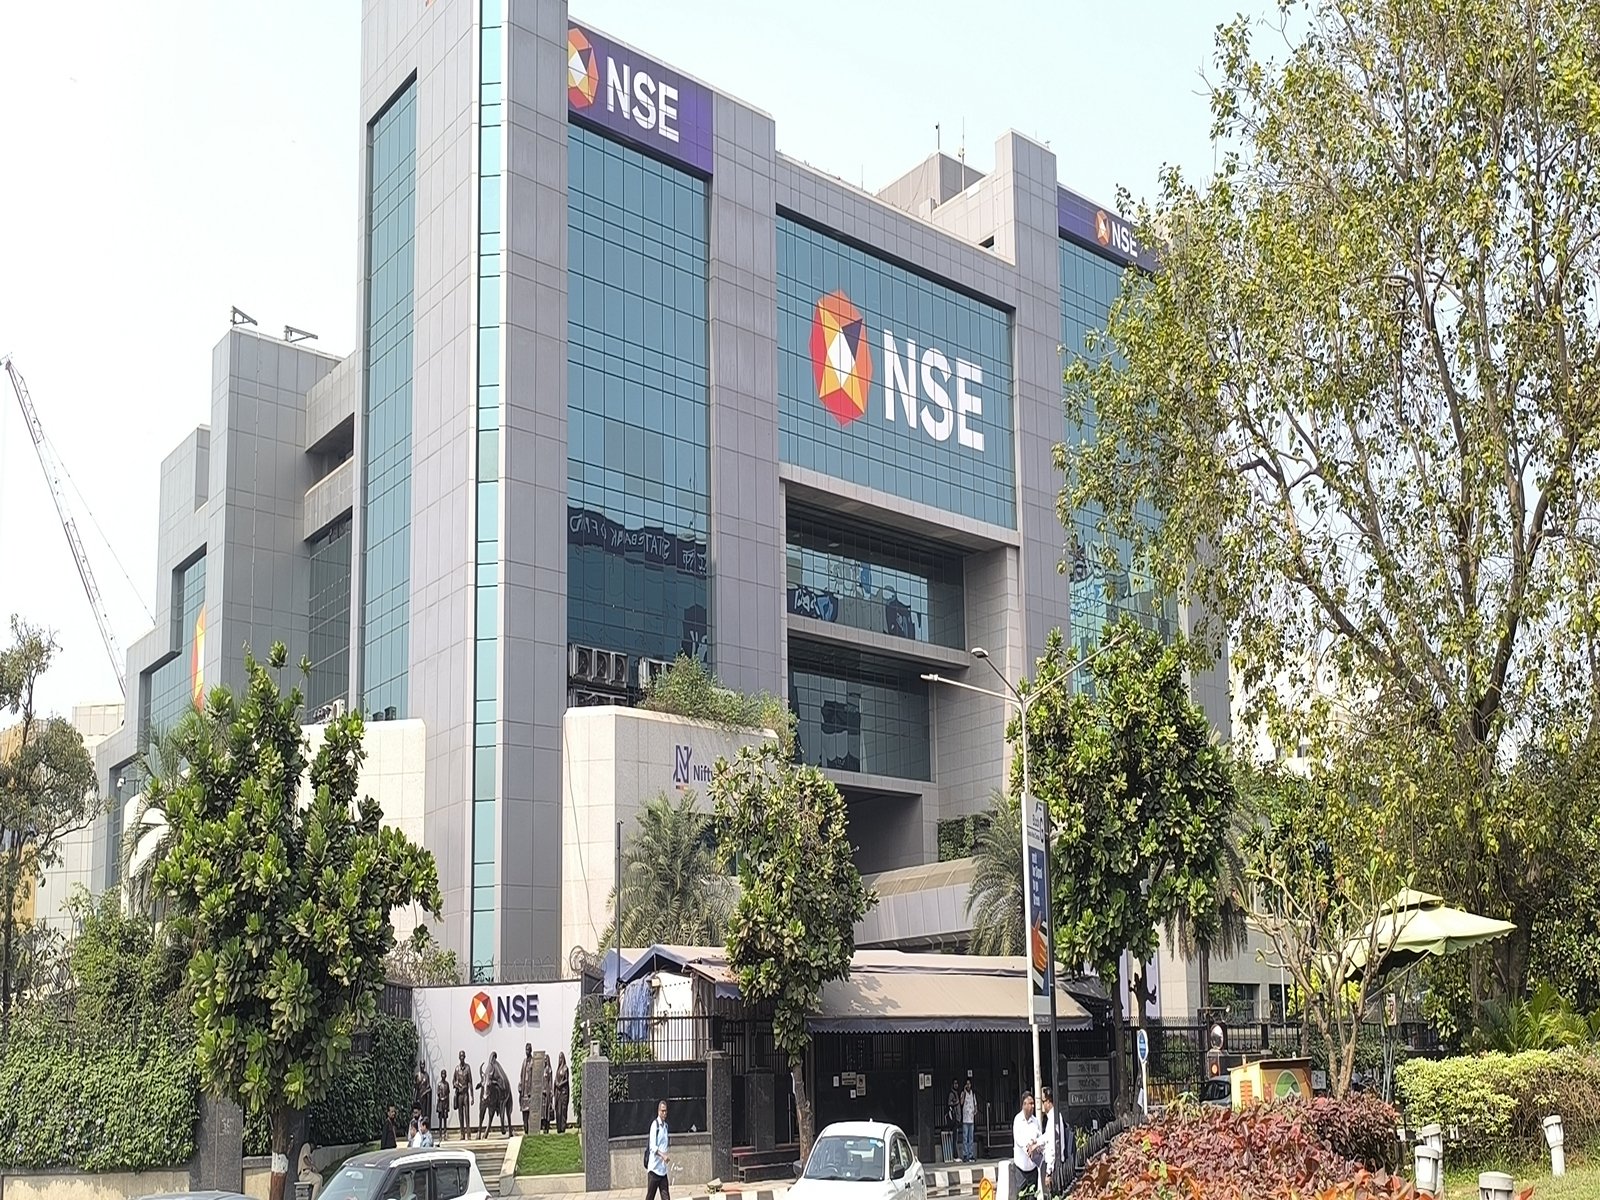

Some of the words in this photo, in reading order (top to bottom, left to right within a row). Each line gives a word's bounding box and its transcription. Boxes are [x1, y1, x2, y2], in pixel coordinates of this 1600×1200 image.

[606, 56, 679, 143] NSE
[1111, 220, 1138, 258] NSE
[883, 328, 985, 452] NSE
[497, 994, 538, 1024] NSE
